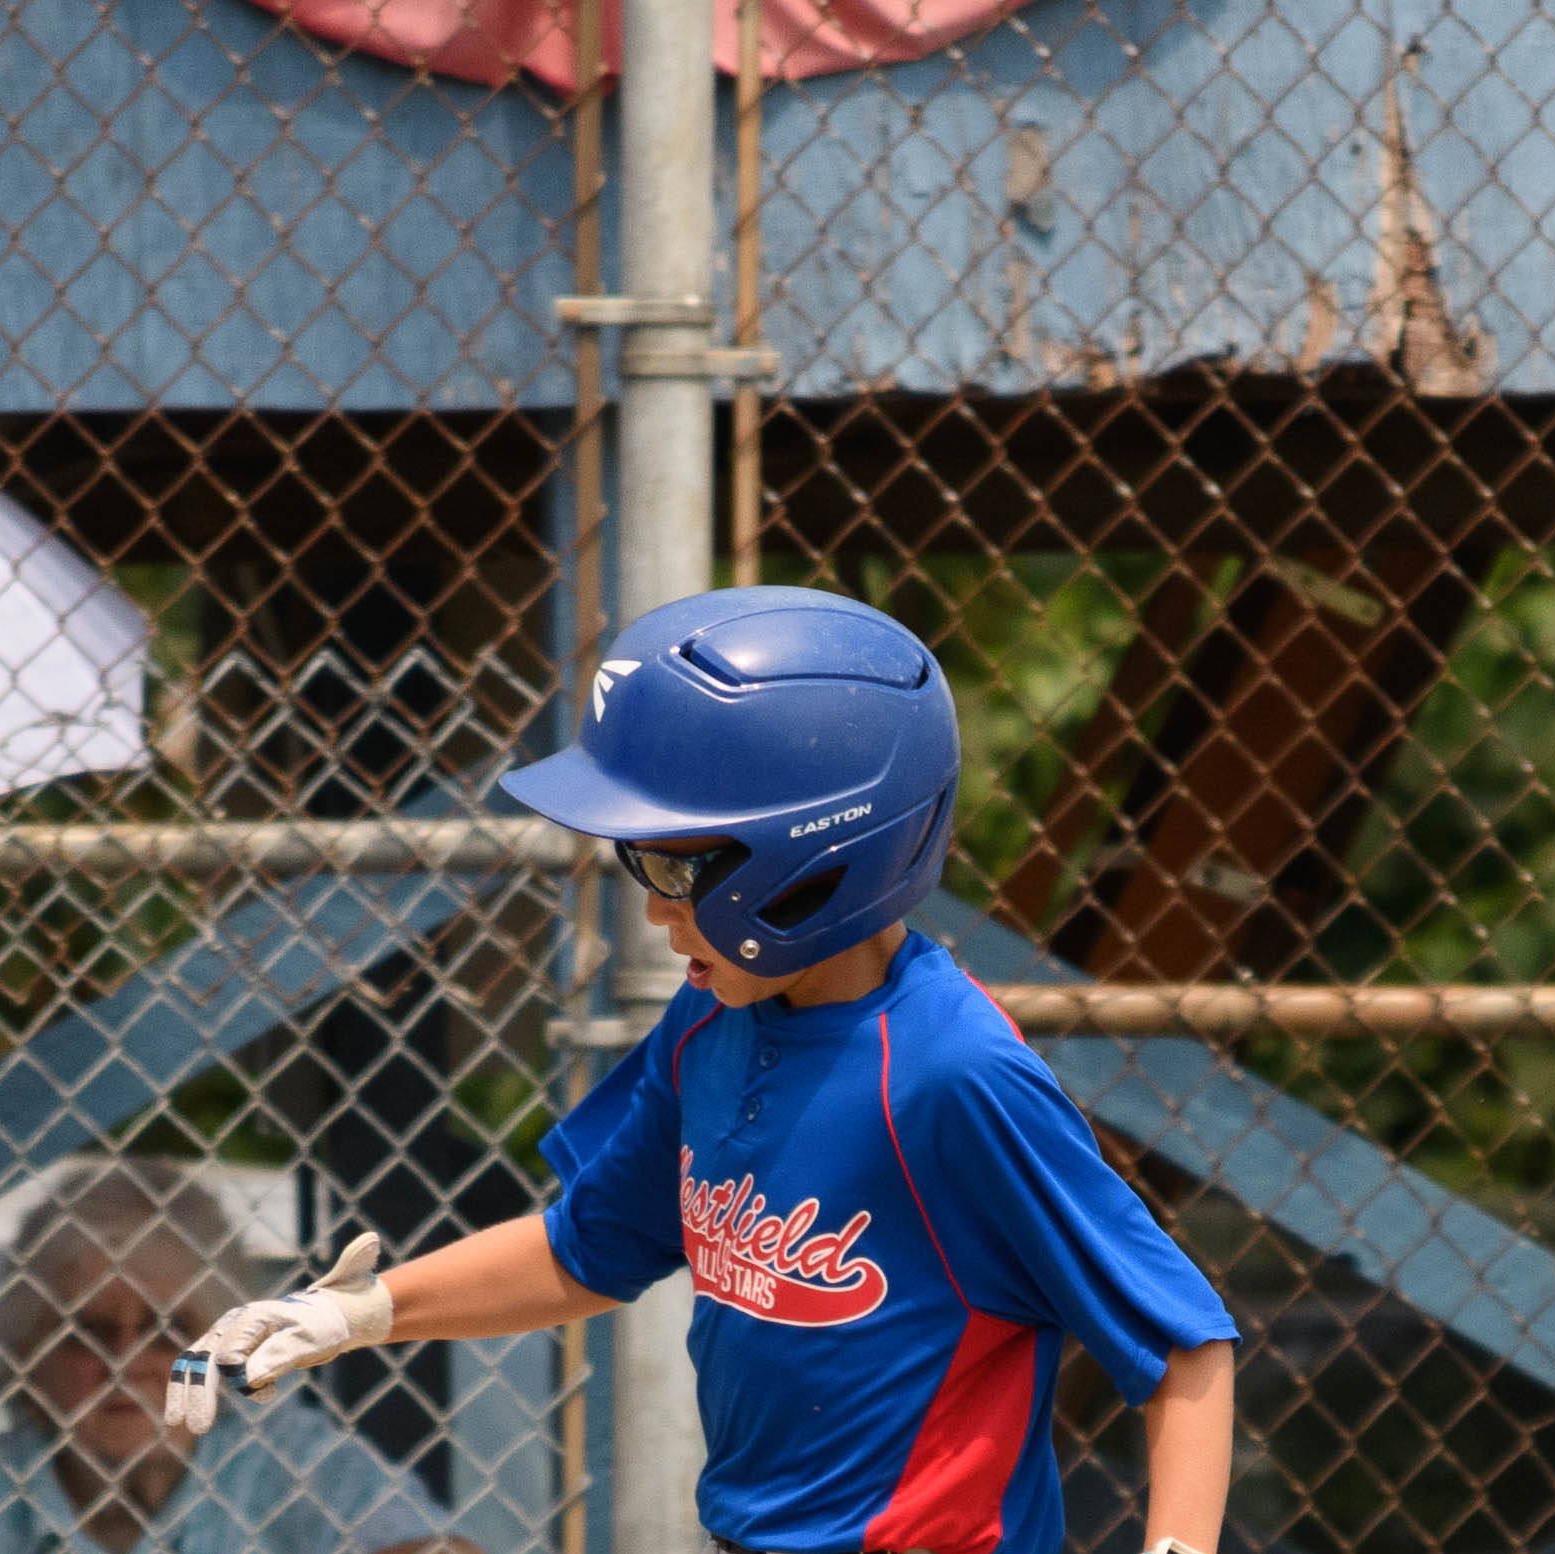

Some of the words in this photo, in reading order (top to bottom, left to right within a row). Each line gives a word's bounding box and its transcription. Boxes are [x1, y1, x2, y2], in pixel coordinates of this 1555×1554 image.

[789, 802, 873, 839] EASTON
[680, 1144, 872, 1285] estfield
[720, 1258, 779, 1311] STARS
